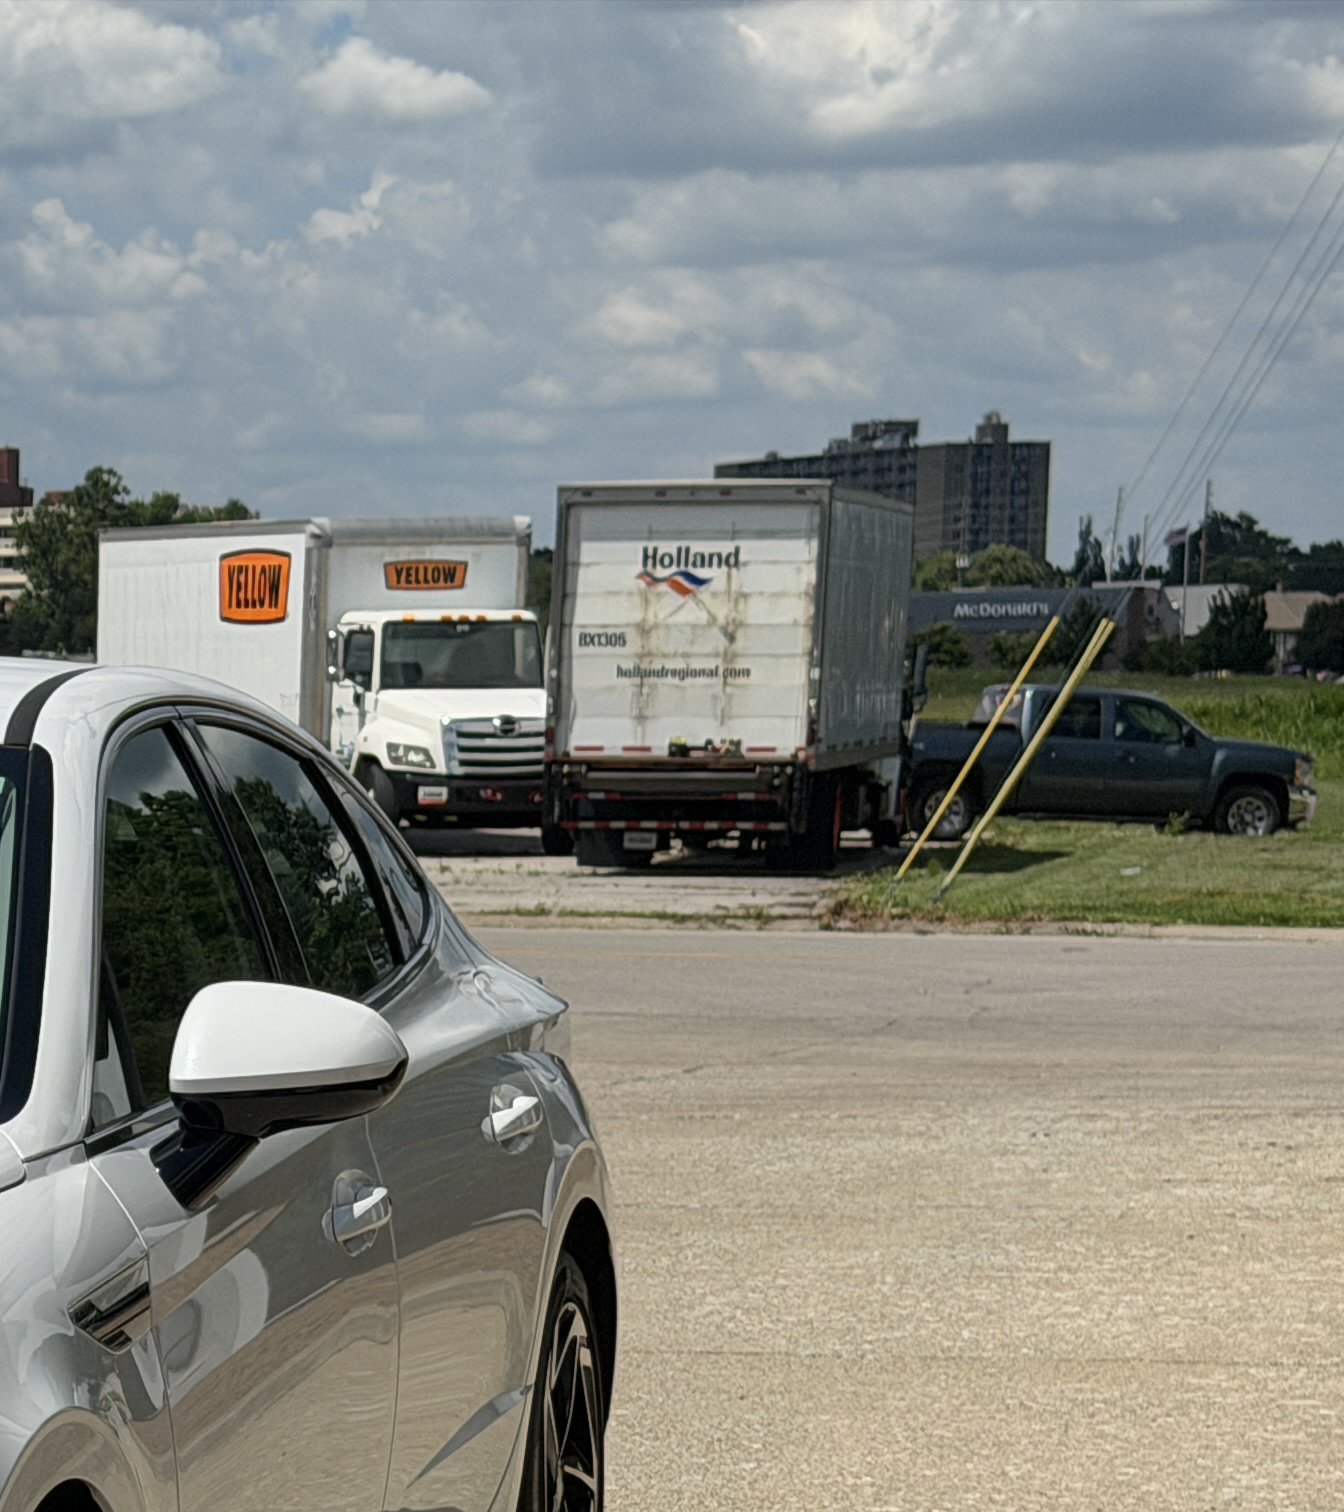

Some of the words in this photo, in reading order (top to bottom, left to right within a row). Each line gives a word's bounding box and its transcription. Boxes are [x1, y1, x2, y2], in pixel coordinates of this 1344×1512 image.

[642, 546, 740, 568] Holland
[227, 564, 282, 609] YELLOW
[394, 566, 457, 585] YELLOW
